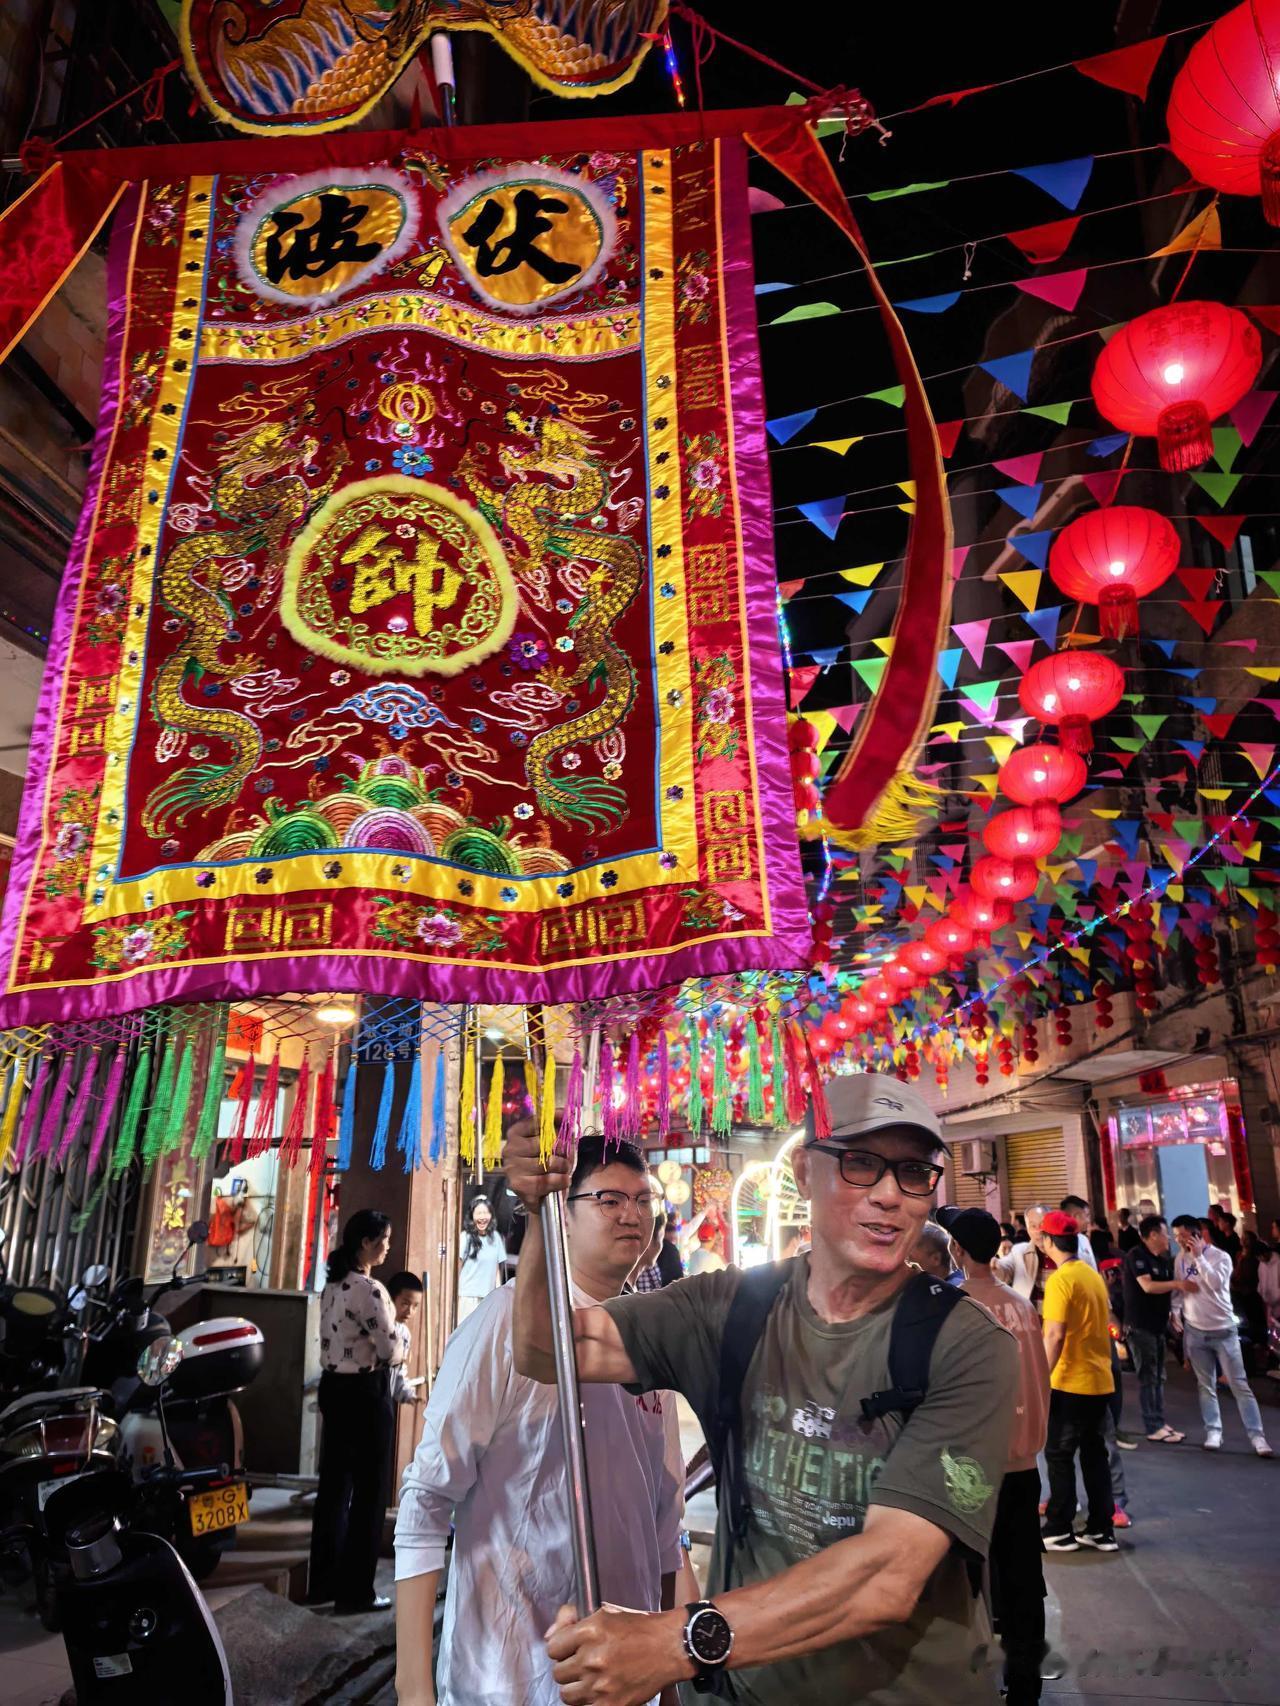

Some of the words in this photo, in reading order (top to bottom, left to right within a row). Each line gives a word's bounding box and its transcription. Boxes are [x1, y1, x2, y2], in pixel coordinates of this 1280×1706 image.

[265, 193, 384, 285] 波
[463, 188, 582, 285] 伏
[195, 1502, 247, 1532] 3208X
